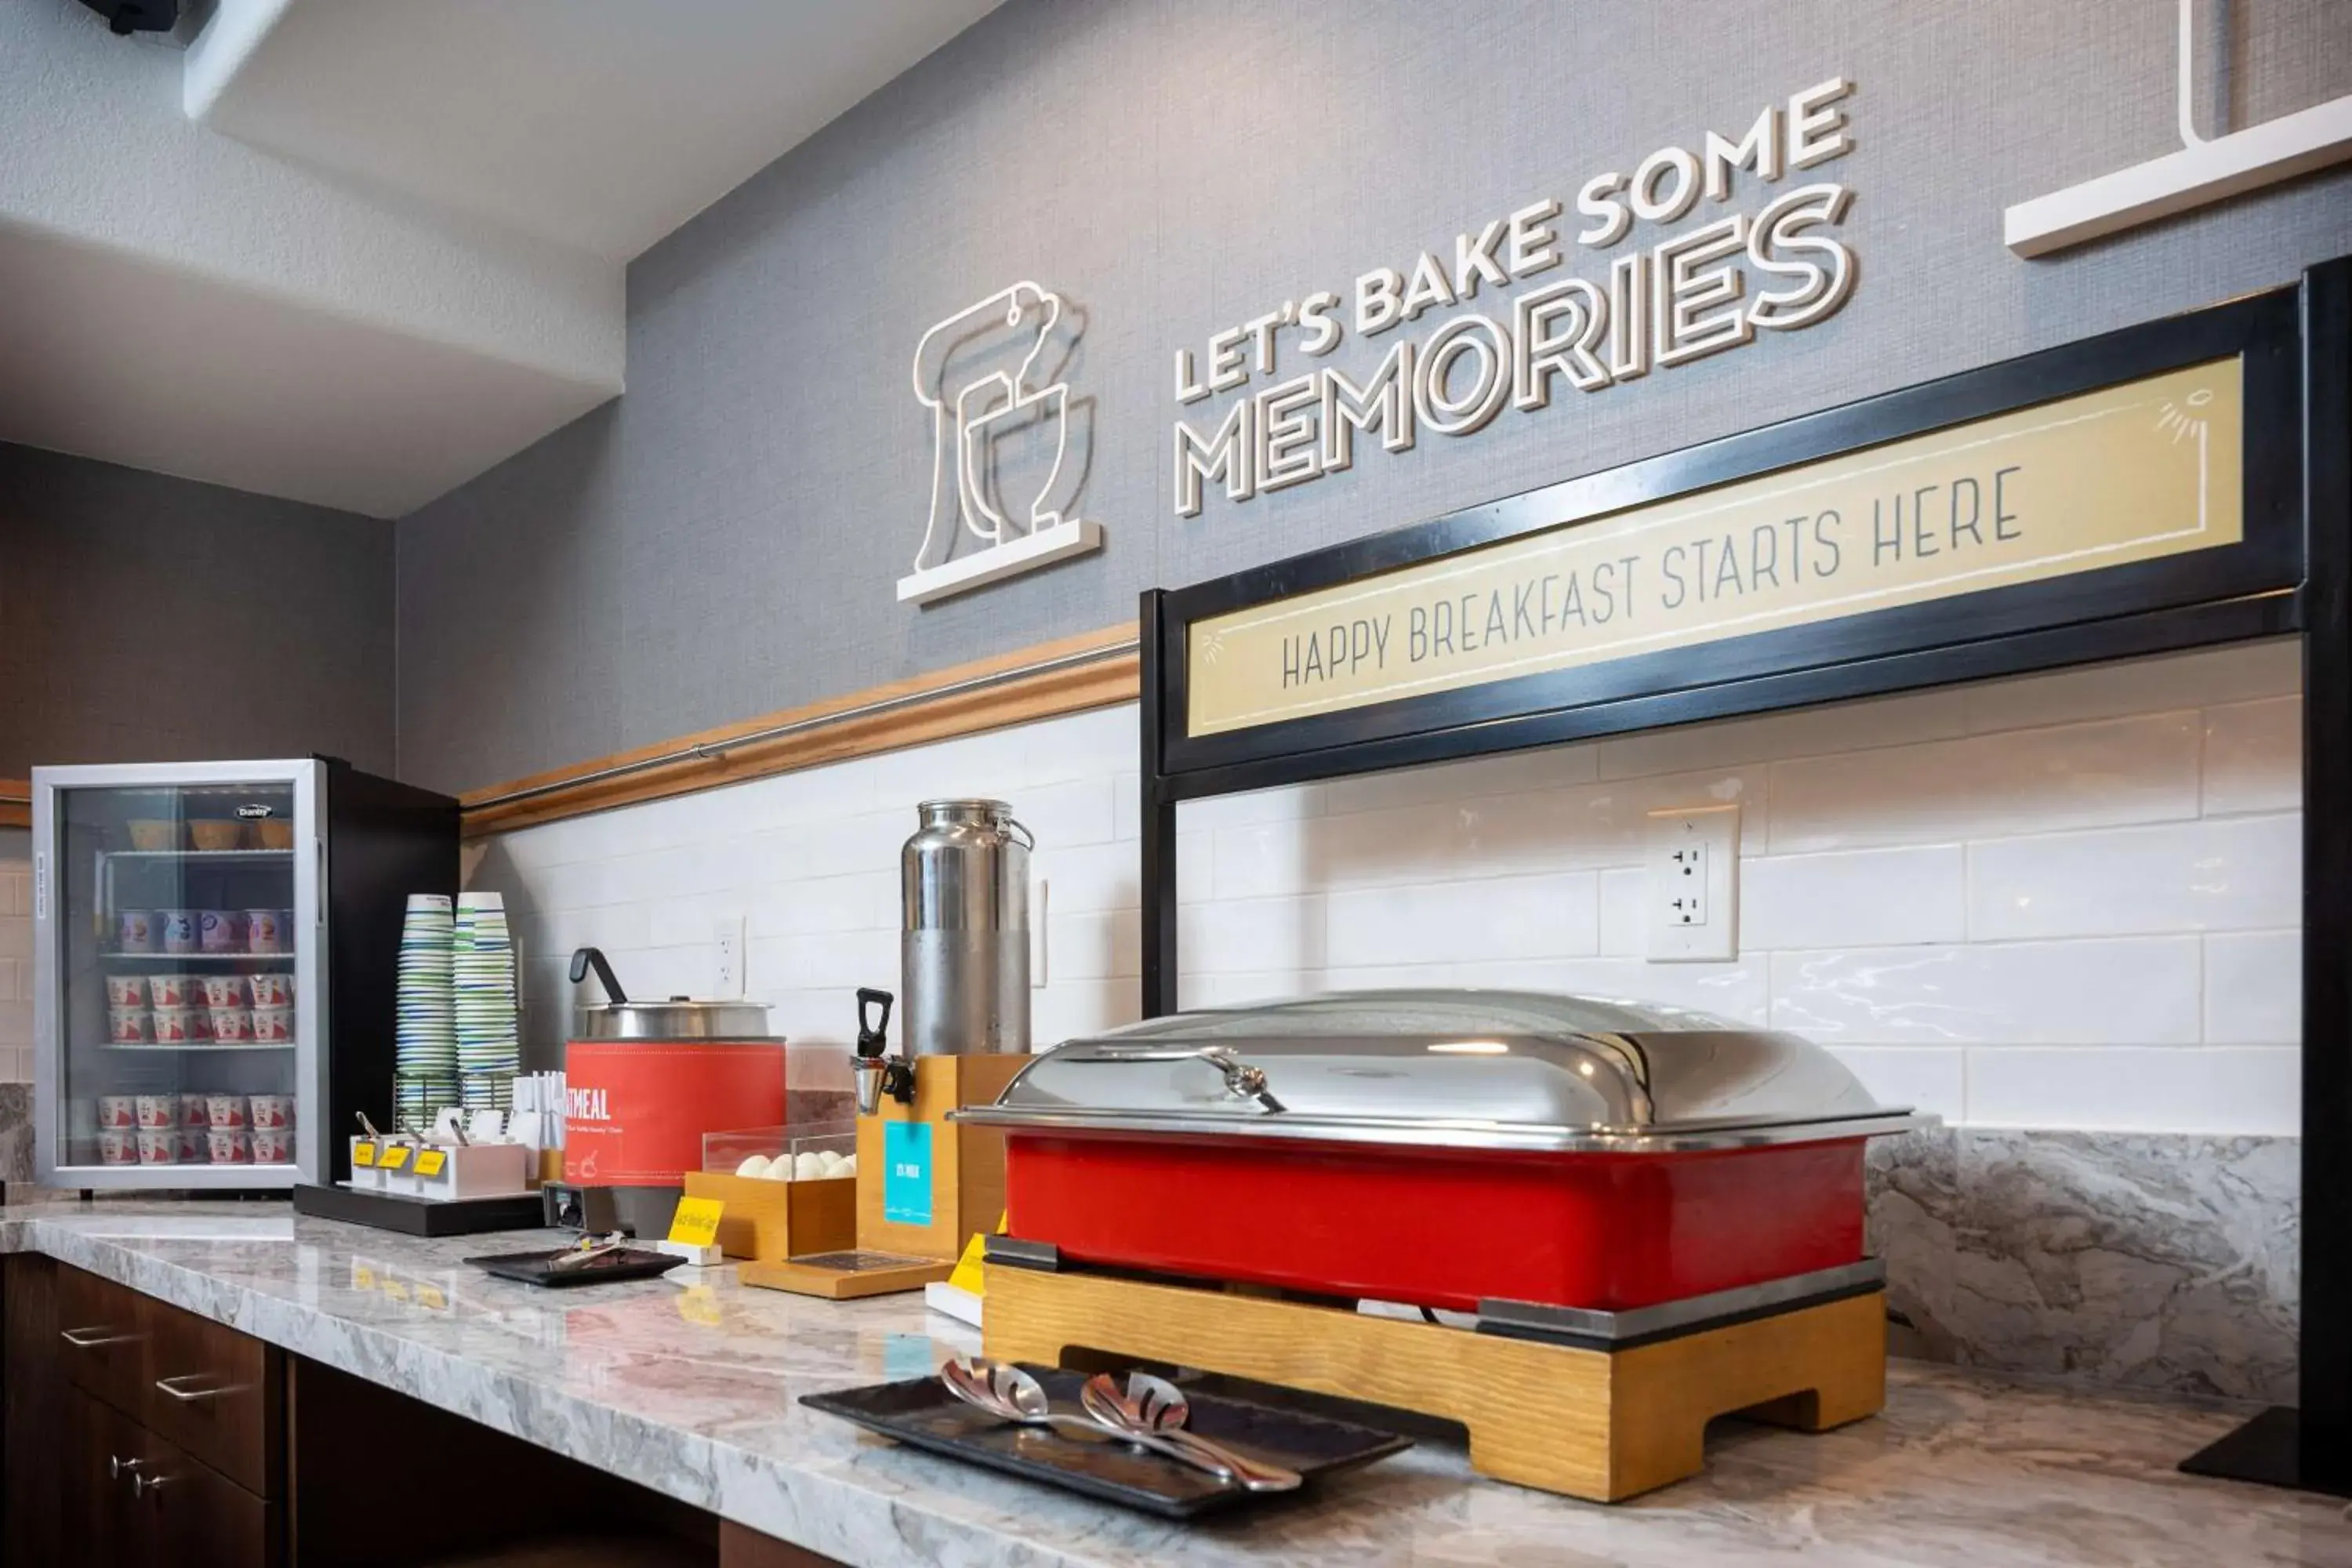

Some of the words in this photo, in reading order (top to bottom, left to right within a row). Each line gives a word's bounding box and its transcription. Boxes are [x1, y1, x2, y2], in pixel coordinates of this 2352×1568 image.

[1173, 183, 1860, 517] MEMORIES
[1174, 290, 1341, 405] LET'S
[1356, 198, 1562, 337] BAKE
[1577, 75, 1855, 249] SOME
[1282, 614, 1392, 689] HAPPY
[1410, 555, 1641, 663] BREAKFAST
[1661, 509, 1842, 609] STARTS
[1873, 466, 2023, 568] HERE
[565, 1087, 612, 1120] TMEAL
